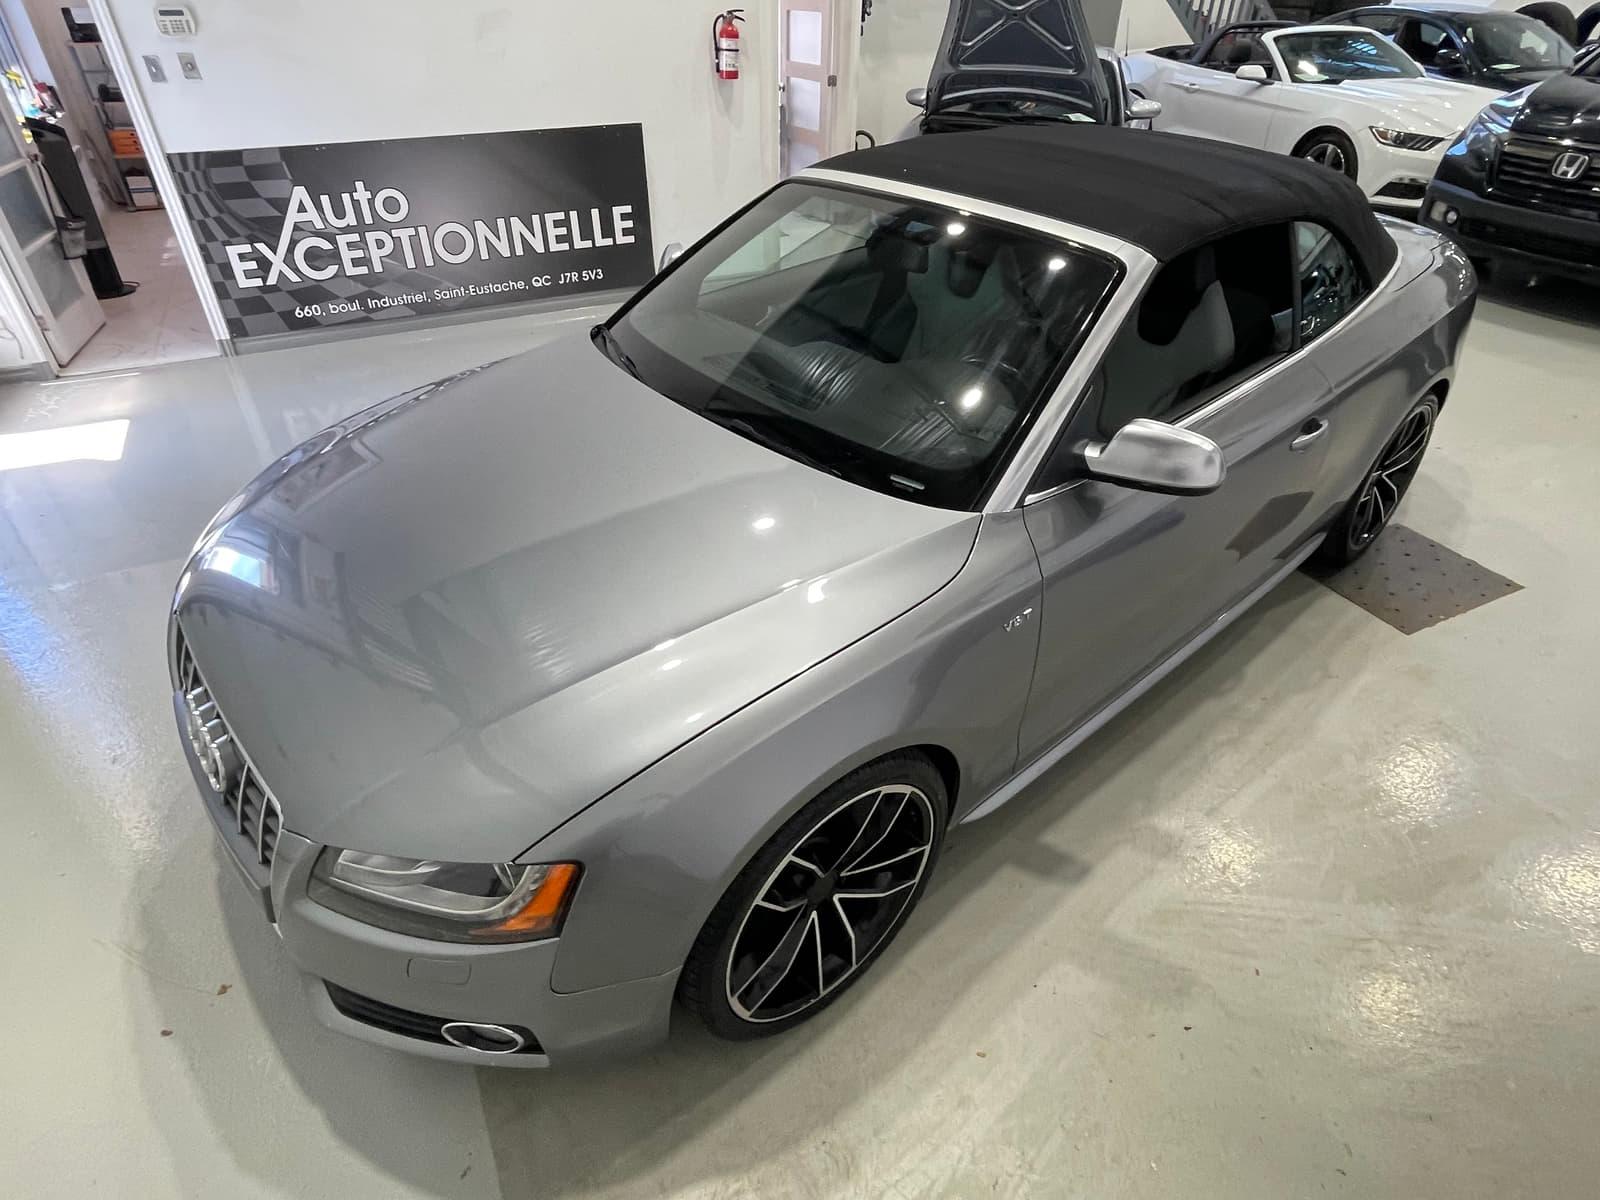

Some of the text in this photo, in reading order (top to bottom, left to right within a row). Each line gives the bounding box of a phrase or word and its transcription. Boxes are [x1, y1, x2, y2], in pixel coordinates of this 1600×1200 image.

[284, 181, 409, 230] Auto
[225, 205, 635, 289] EXCEPTIONNELLE
[295, 269, 604, 318] 660, boul. Industriel, Saint-Eustache, QC J7R 5V3
